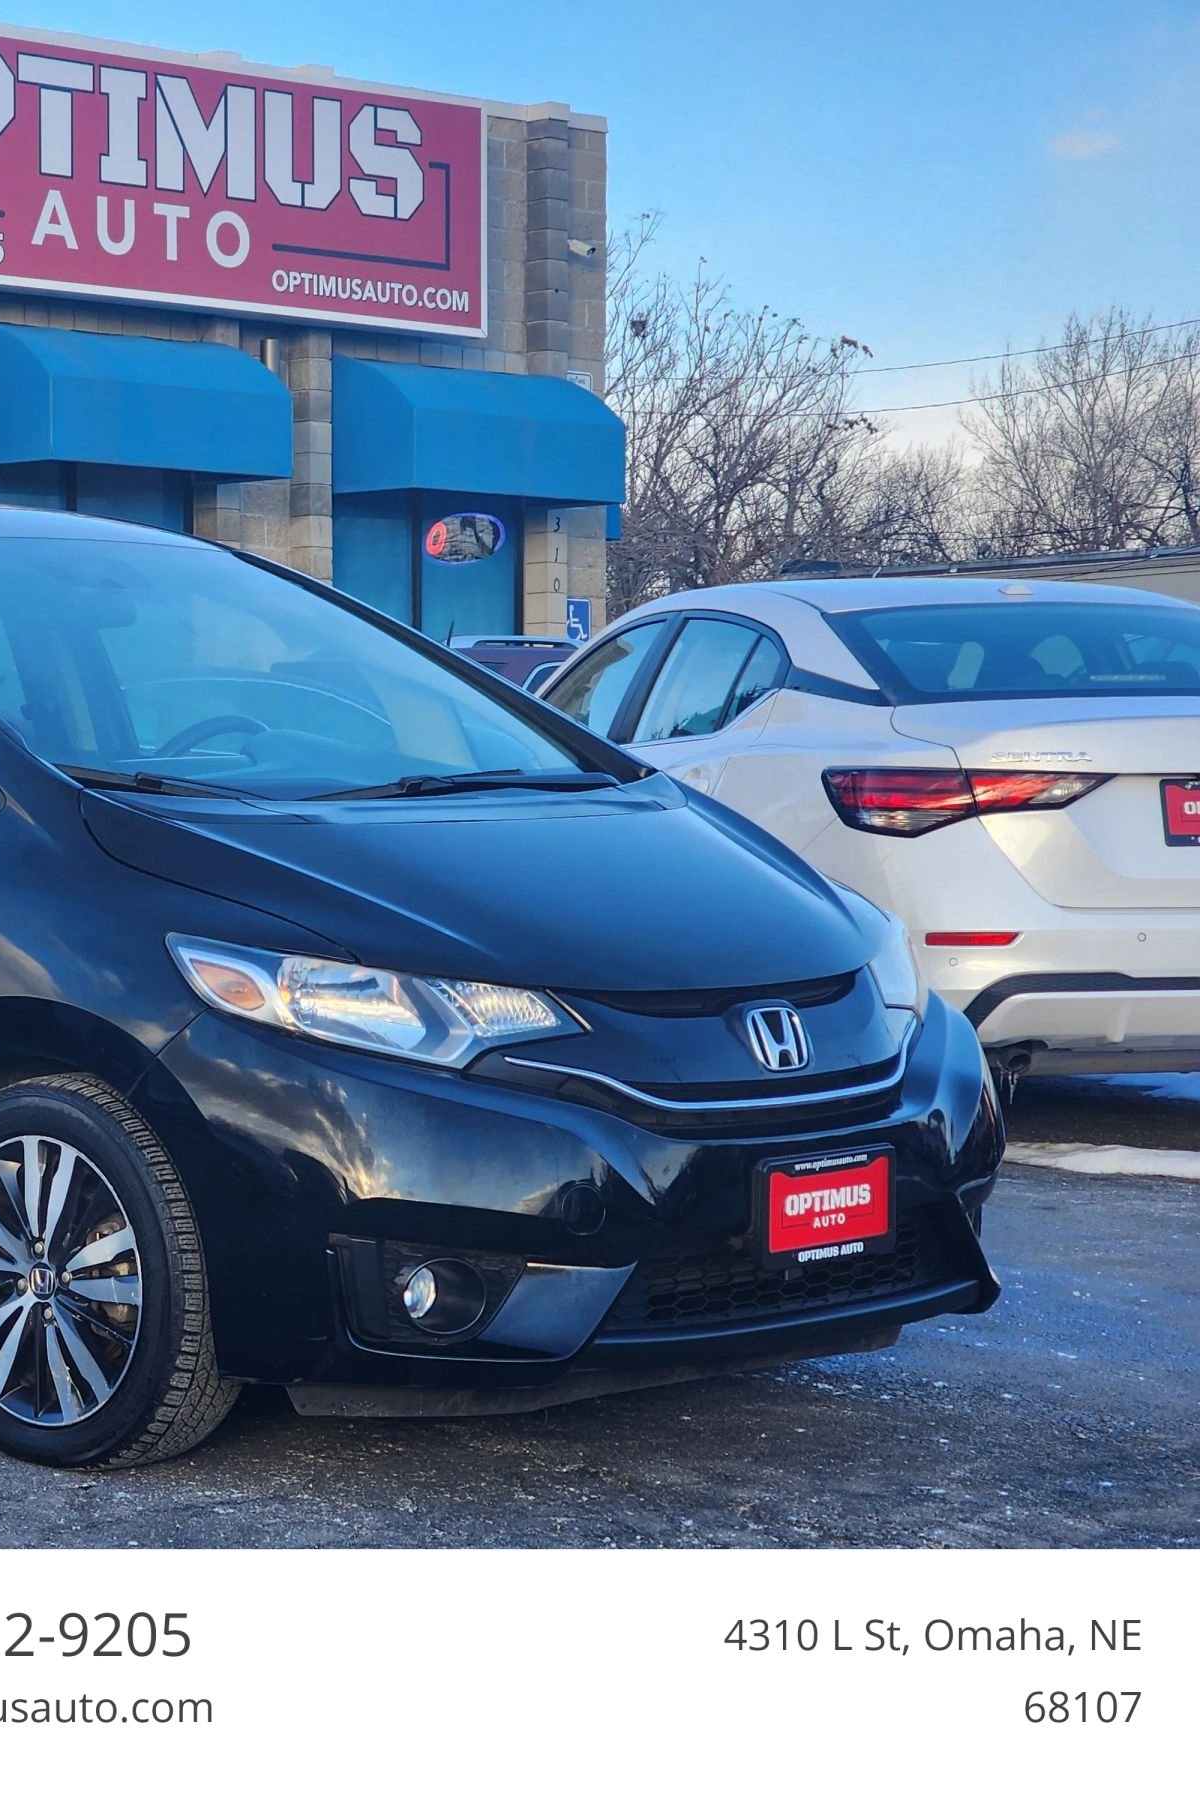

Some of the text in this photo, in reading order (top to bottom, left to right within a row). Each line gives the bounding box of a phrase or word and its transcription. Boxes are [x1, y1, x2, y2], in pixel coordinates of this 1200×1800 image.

[30, 190, 251, 268] AUTO
[271, 268, 470, 314] OPTIMUSAUTO.COM
[991, 751, 1093, 763] SENTRA
[794, 1154, 868, 1172] www.optimusauto.com
[785, 1183, 871, 1217] OPTIMUS
[813, 1212, 846, 1229] AUTO
[798, 1242, 864, 1263] OPTIMUS AUTO
